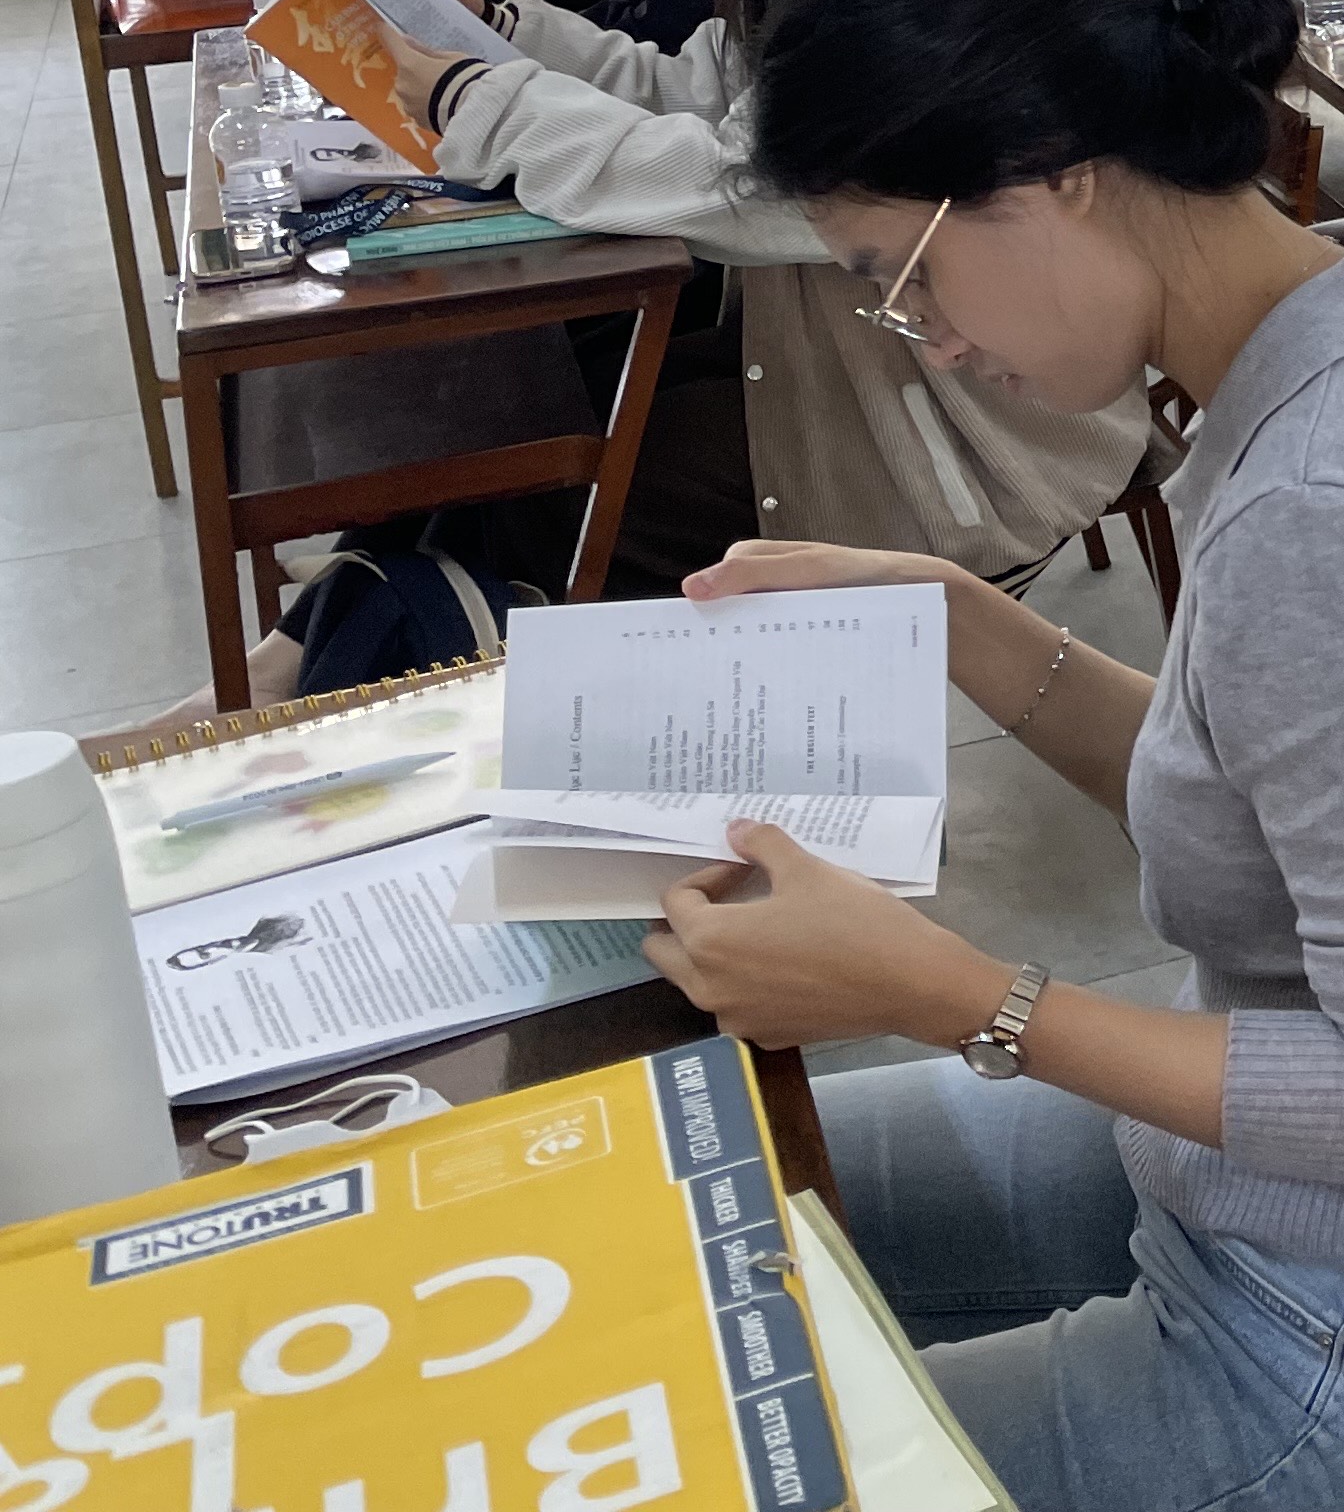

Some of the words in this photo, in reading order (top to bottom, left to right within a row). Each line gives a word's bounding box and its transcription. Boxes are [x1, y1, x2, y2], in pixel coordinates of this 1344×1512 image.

[569, 695, 583, 742] Contents
[807, 705, 816, 723] TEXT
[806, 725, 816, 758] ENGLISH
[806, 759, 815, 774] THE
[569, 775, 581, 791] ục
[671, 1054, 707, 1095] NEW!
[677, 1090, 724, 1165] IMPROVED!
[707, 1176, 740, 1227] THICKER
[127, 1192, 328, 1264] TRUTONE
[0, 1254, 571, 1454] Cop
[736, 1309, 775, 1381] SMOOTHER
[757, 1397, 792, 1451] BETTER
[766, 1446, 806, 1506] OPACITY
